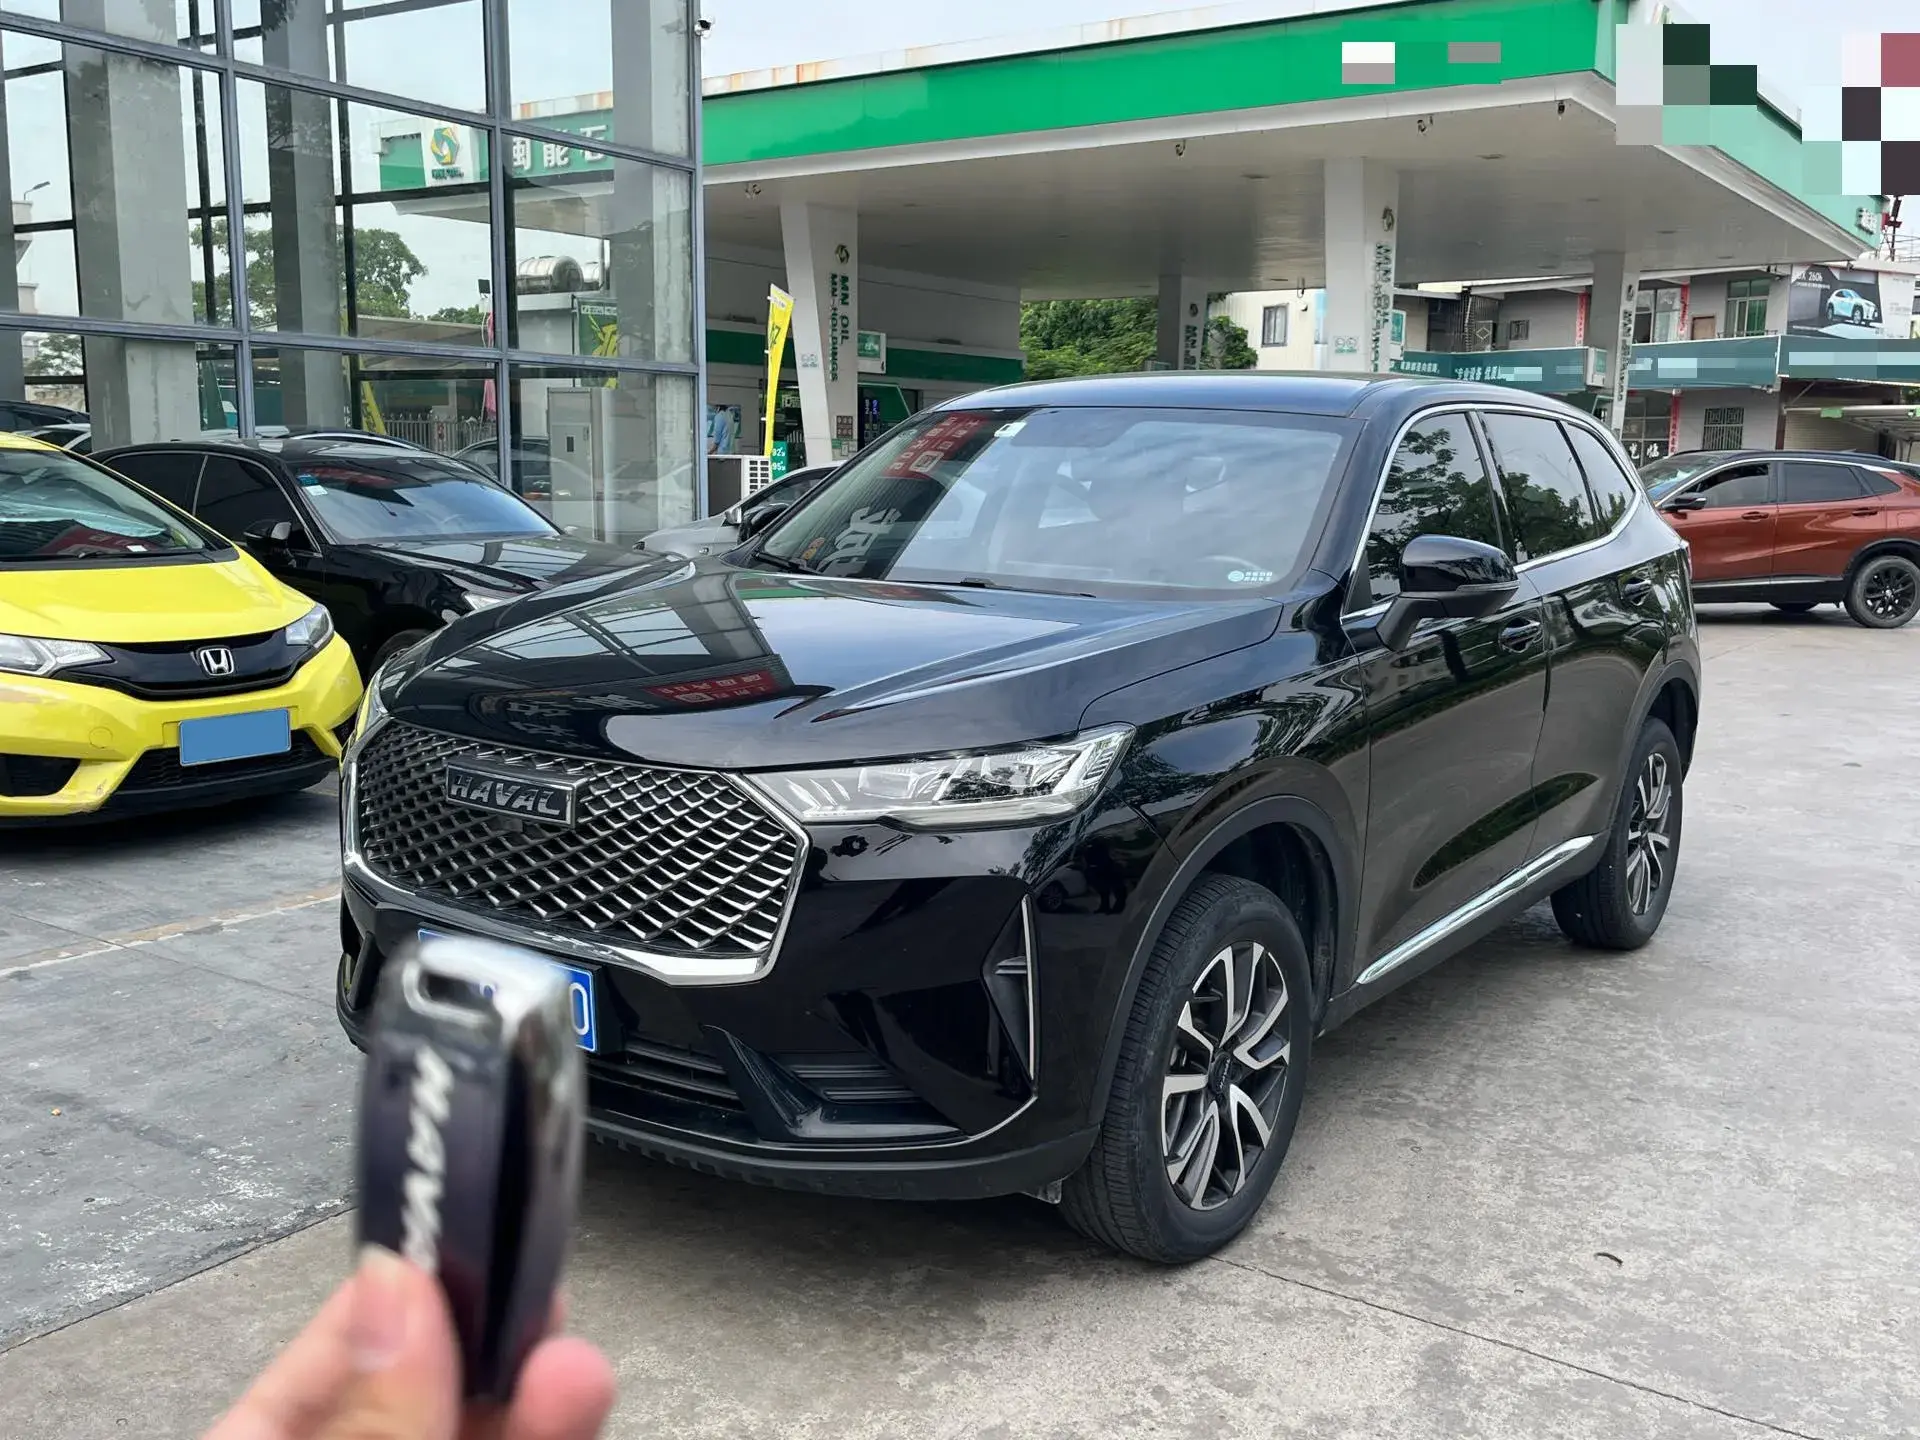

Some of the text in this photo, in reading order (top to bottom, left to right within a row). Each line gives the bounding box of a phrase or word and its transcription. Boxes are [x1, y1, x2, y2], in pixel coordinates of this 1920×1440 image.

[839, 274, 850, 345] MN OIL
[450, 774, 560, 815] HAVAL
